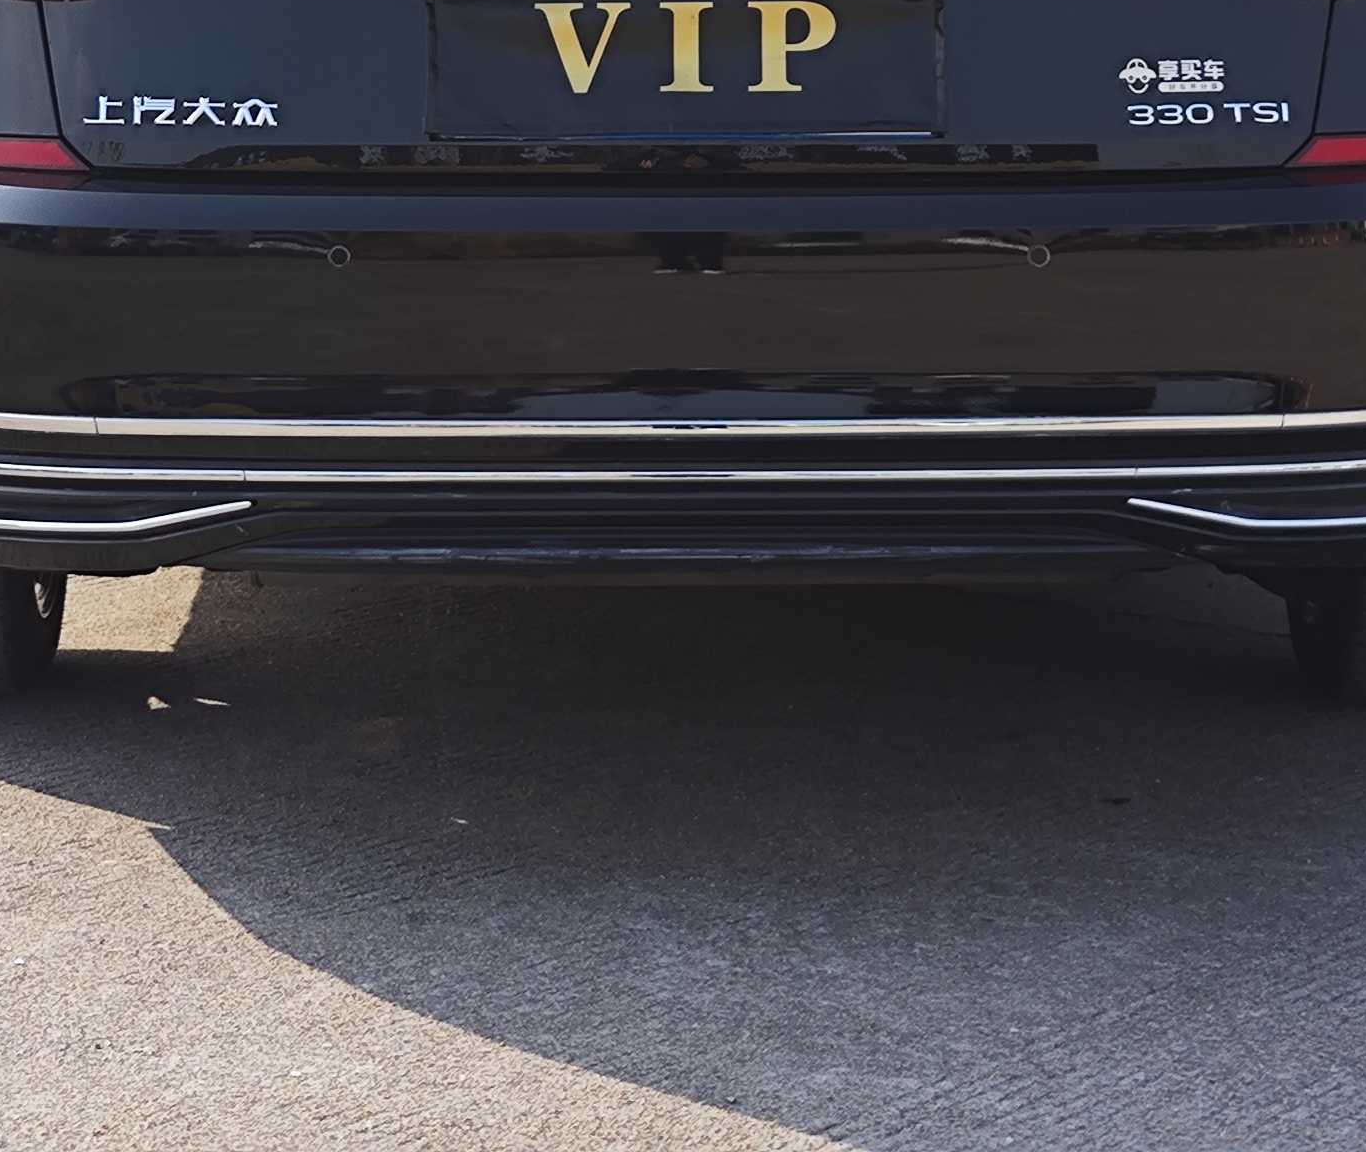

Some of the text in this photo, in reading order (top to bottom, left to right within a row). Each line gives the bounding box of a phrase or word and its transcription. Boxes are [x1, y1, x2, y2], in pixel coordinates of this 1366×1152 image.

[534, 1, 836, 94] VIP
[1157, 59, 1225, 80] 享买车
[83, 96, 278, 126] 上汽大众
[1127, 102, 1289, 125] 330 TSI
